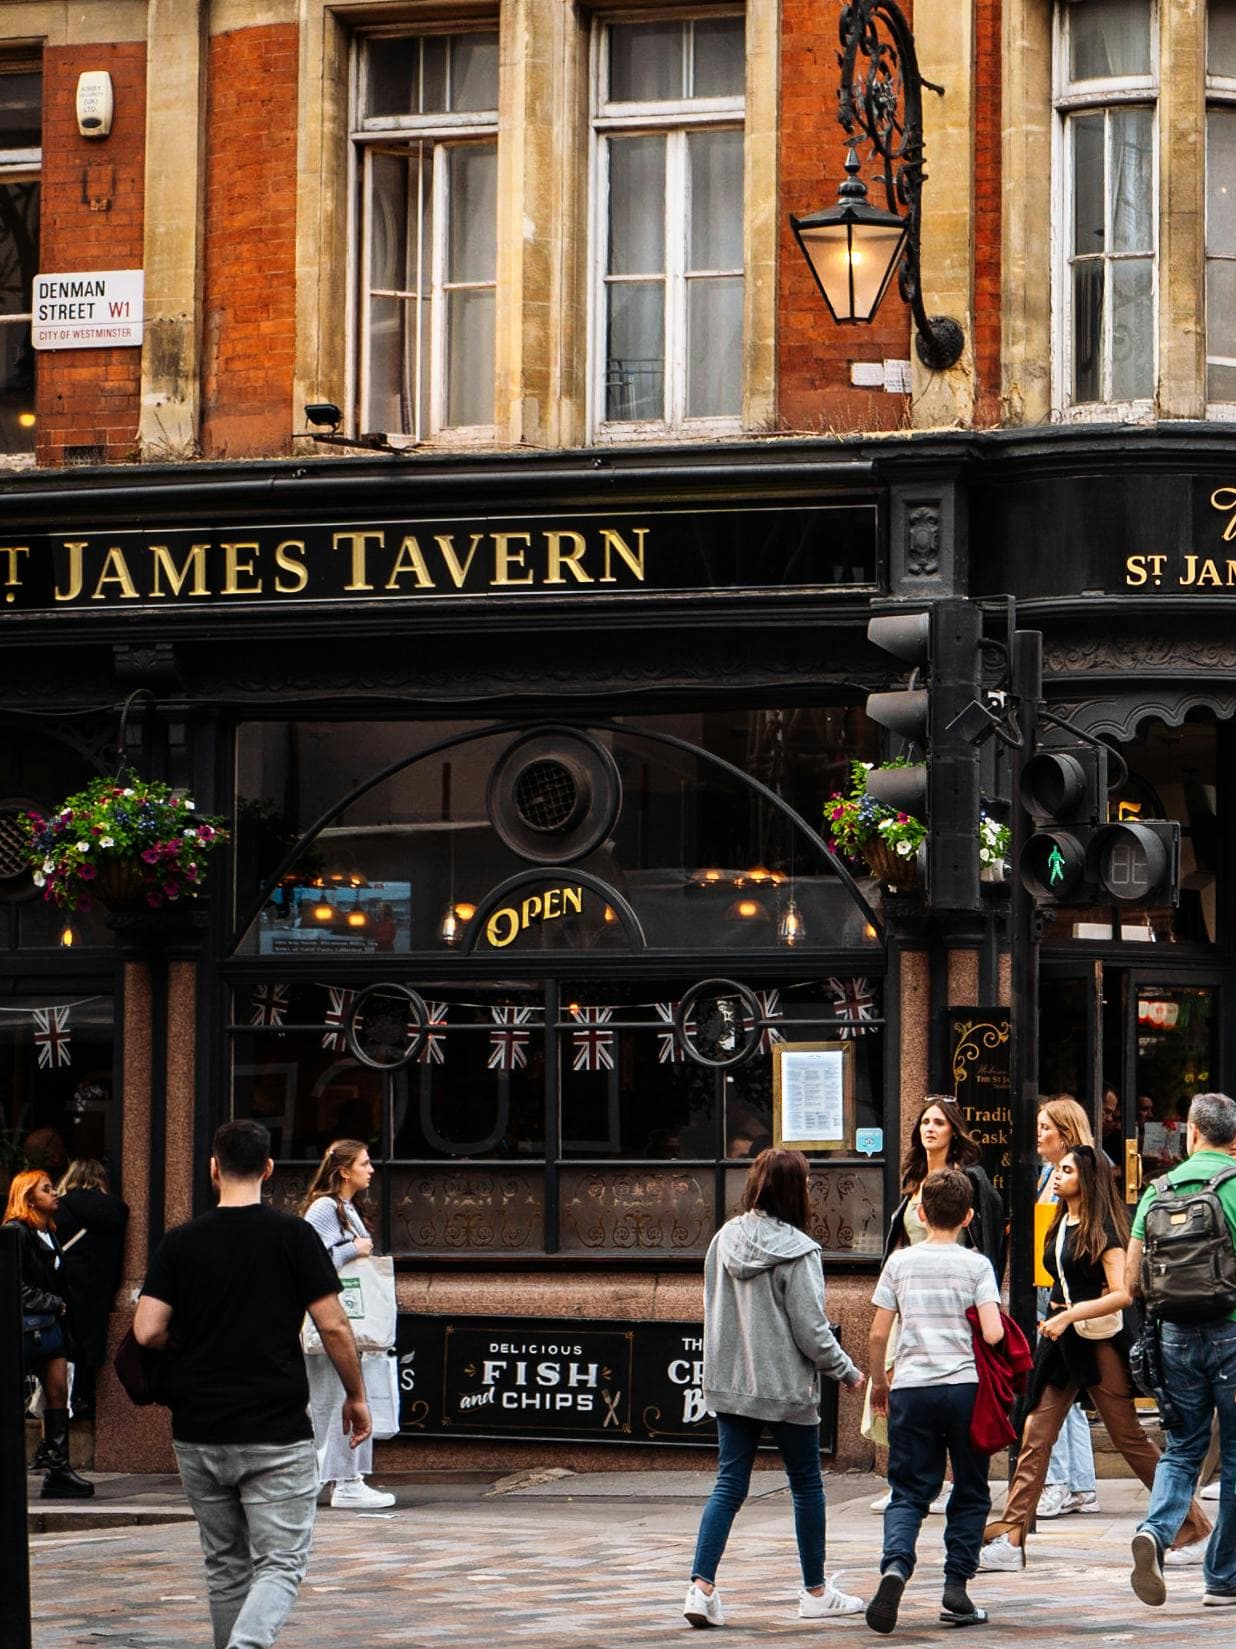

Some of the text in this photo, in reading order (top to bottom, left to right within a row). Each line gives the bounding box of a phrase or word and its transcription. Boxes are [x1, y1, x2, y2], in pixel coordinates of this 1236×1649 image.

[39, 280, 106, 299] DENMAN
[39, 301, 130, 321] STREET W1
[39, 327, 132, 341] CITY OF WESTMINSTER
[55, 540, 310, 601] JAMES
[333, 528, 650, 591] TAVERN
[486, 886, 582, 948] OPEN
[489, 1343, 583, 1355] DELICIOUS
[681, 1337, 704, 1351] TH
[481, 1360, 599, 1388] FISH
[459, 1386, 594, 1411] and CHIPS
